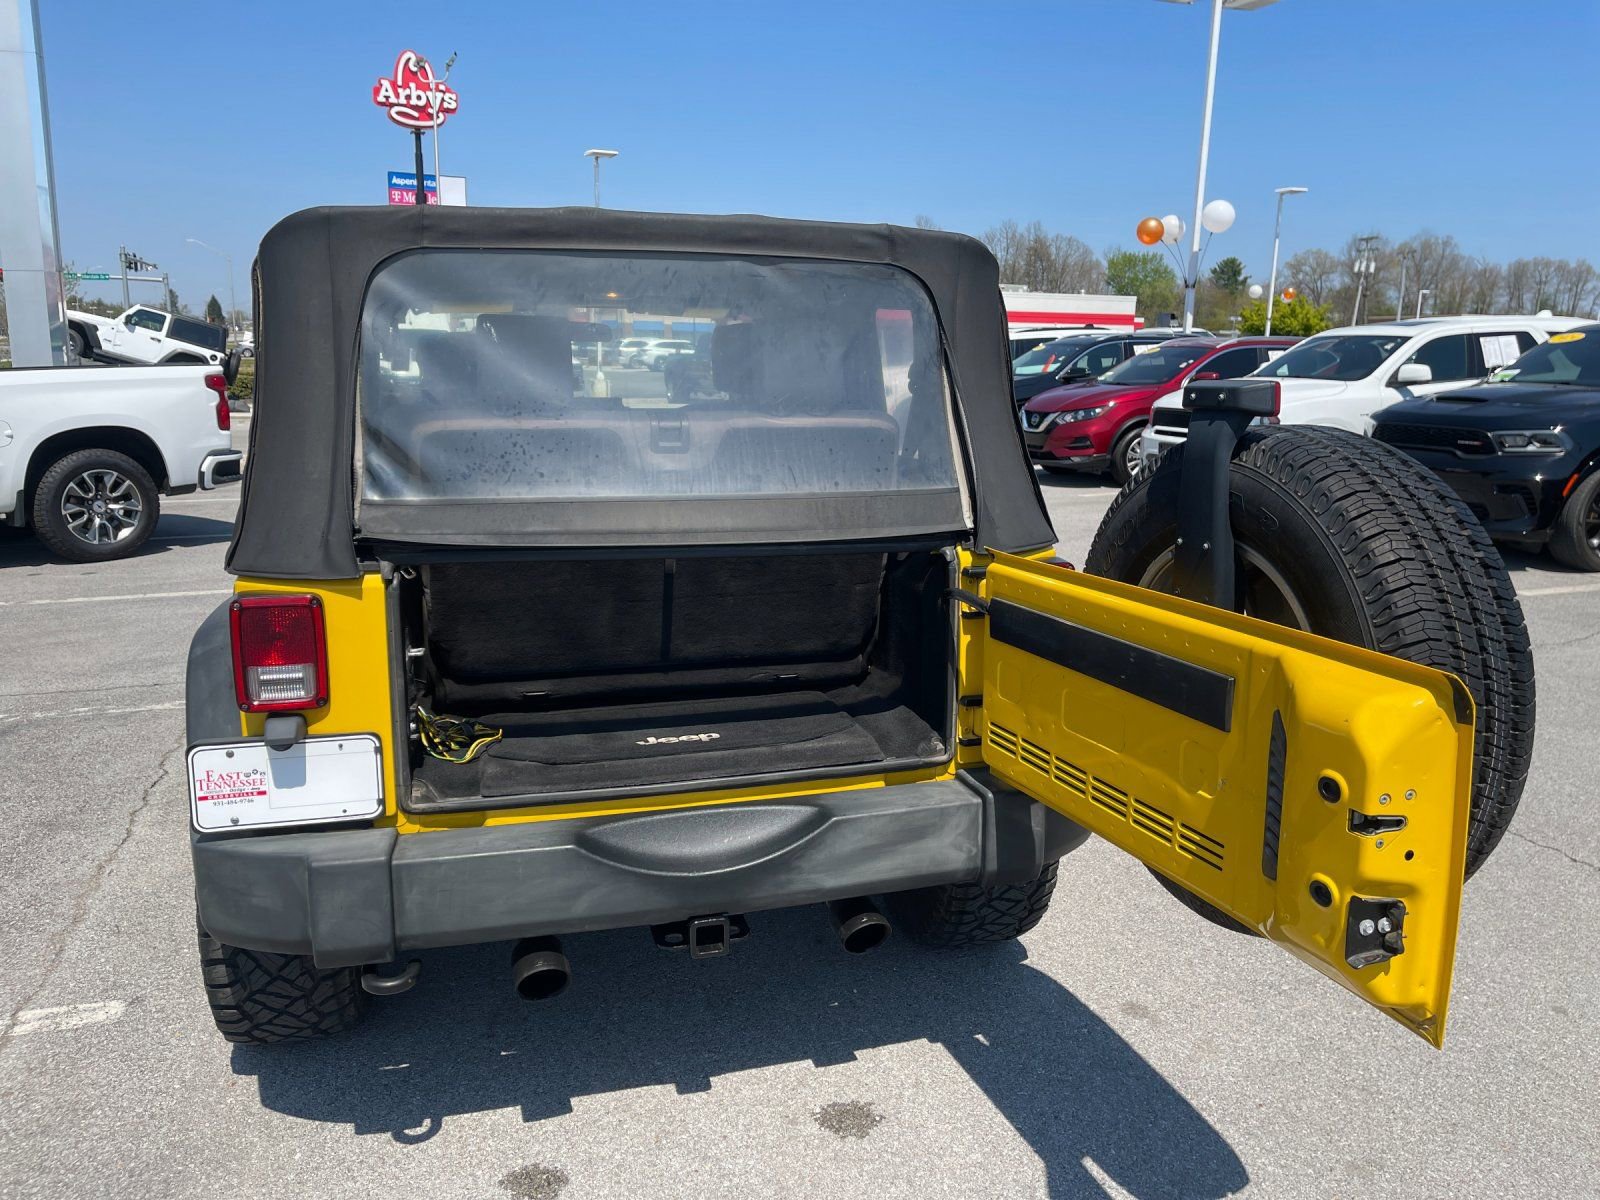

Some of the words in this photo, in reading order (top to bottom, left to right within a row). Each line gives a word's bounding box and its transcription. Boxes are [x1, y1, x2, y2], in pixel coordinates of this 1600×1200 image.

[377, 79, 458, 114] Arby's
[635, 732, 721, 745] Jeep
[206, 770, 243, 783] EAST
[196, 778, 266, 791] TENNESSEE
